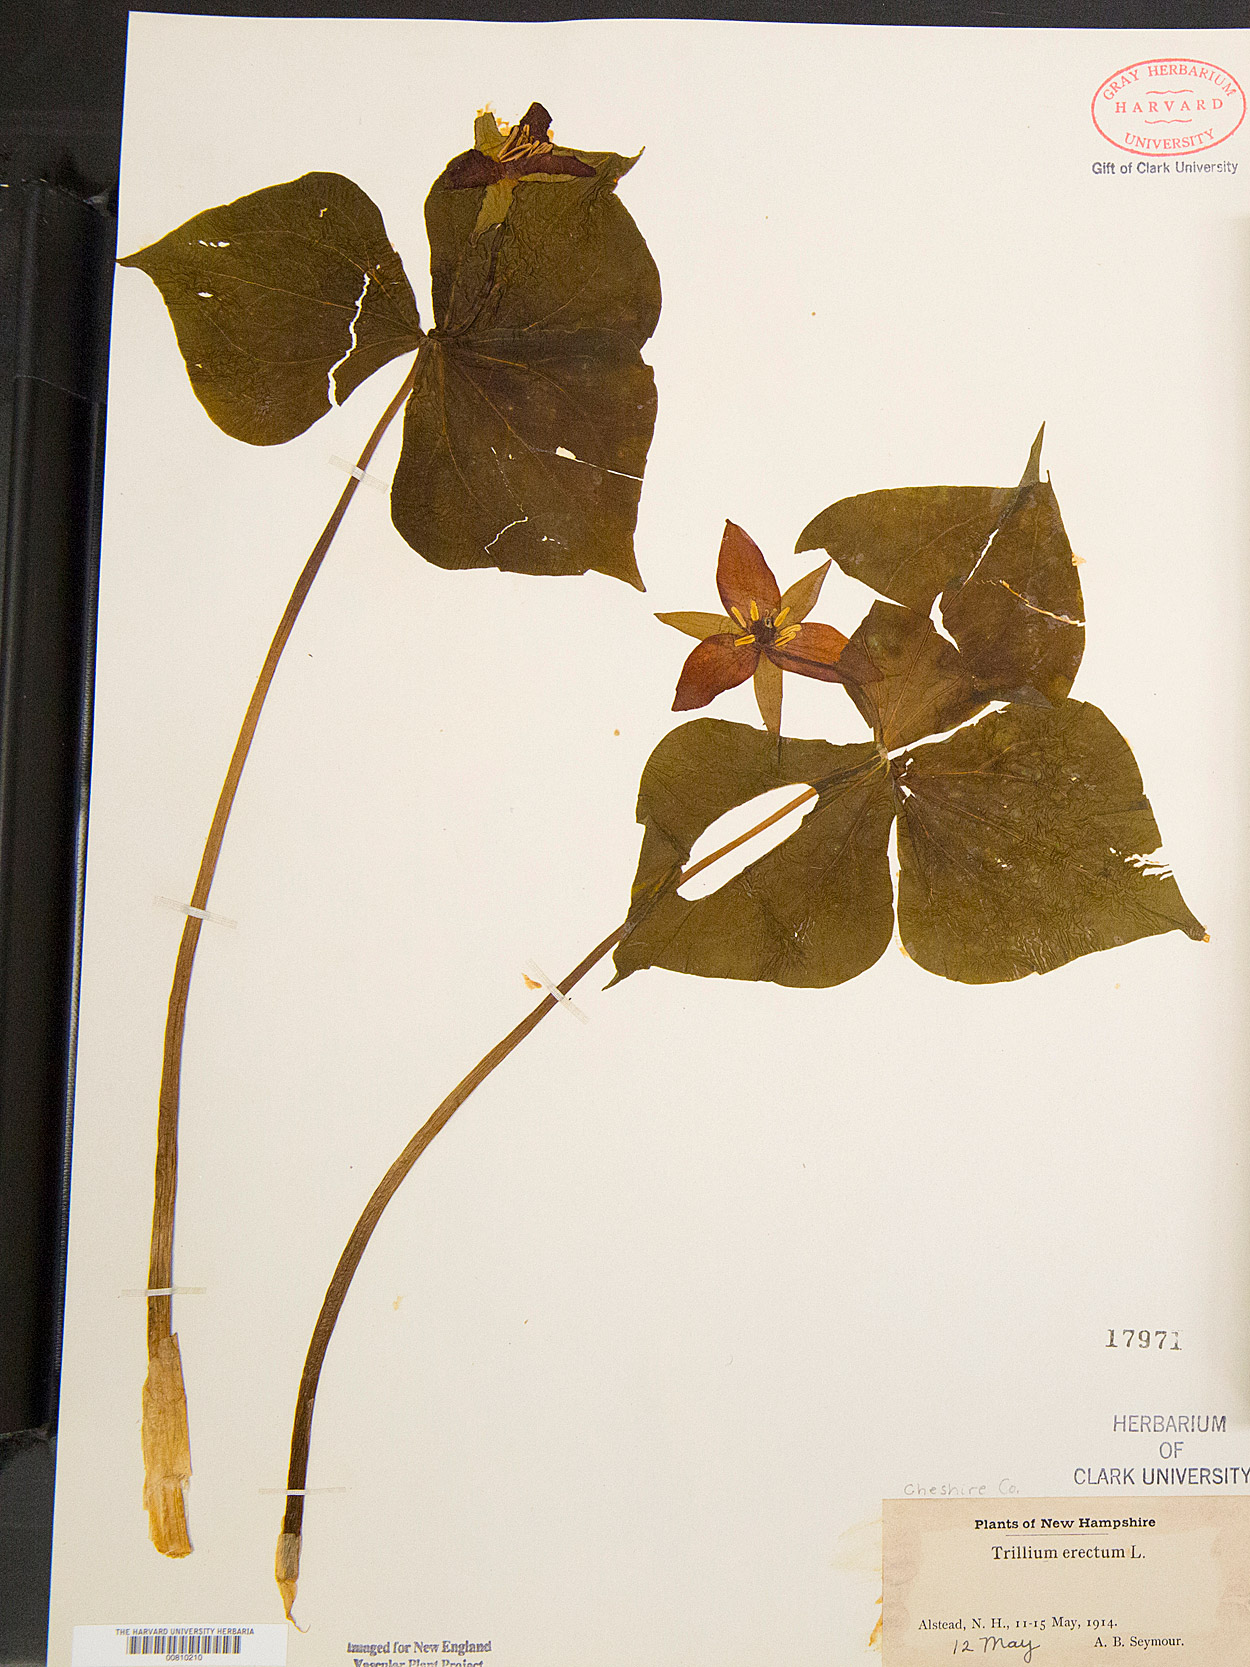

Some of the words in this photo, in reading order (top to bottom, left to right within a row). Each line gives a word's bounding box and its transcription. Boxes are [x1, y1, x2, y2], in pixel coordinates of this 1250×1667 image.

[1103, 69, 1140, 101] GRAY
[1148, 64, 1237, 97] HERBARIUM
[1115, 98, 1223, 113] HARVARD
[1124, 128, 1216, 150] UNIVERSITY
[1091, 161, 1116, 175] Gift
[1120, 161, 1133, 174] of
[1136, 161, 1170, 174] Clark
[1175, 160, 1239, 174] University
[1105, 1329, 1183, 1351] 17971
[1113, 1415, 1227, 1433] HERBARIUM
[1159, 1442, 1184, 1459] OF
[1073, 1468, 1135, 1485] CLARK
[903, 1480, 987, 1496] Cheshire
[998, 1478, 1020, 1496] Co.
[974, 1518, 1019, 1530] Plants
[1022, 1518, 1038, 1530] of
[1041, 1518, 1075, 1530] New
[1078, 1517, 1156, 1530] Hampshire
[992, 1545, 1058, 1560] Trillium
[1062, 1546, 1126, 1559] erectum
[1130, 1545, 1146, 1559] L.
[918, 1618, 966, 1632] Alstead,
[971, 1618, 986, 1630] N.
[990, 1617, 1010, 1631] H.,
[1015, 1618, 1047, 1631] 11-15
[1052, 1617, 1081, 1631] May,
[1086, 1618, 1118, 1630] 1914.
[347, 1641, 391, 1656] Imaged
[393, 1641, 411, 1654] for
[414, 1641, 439, 1653] New
[441, 1640, 492, 1656] England
[952, 1638, 974, 1654] 12
[981, 1636, 1041, 1663] May
[1094, 1636, 1108, 1648] A.
[1113, 1636, 1126, 1648] B.
[1129, 1636, 1185, 1649] Seymour.
